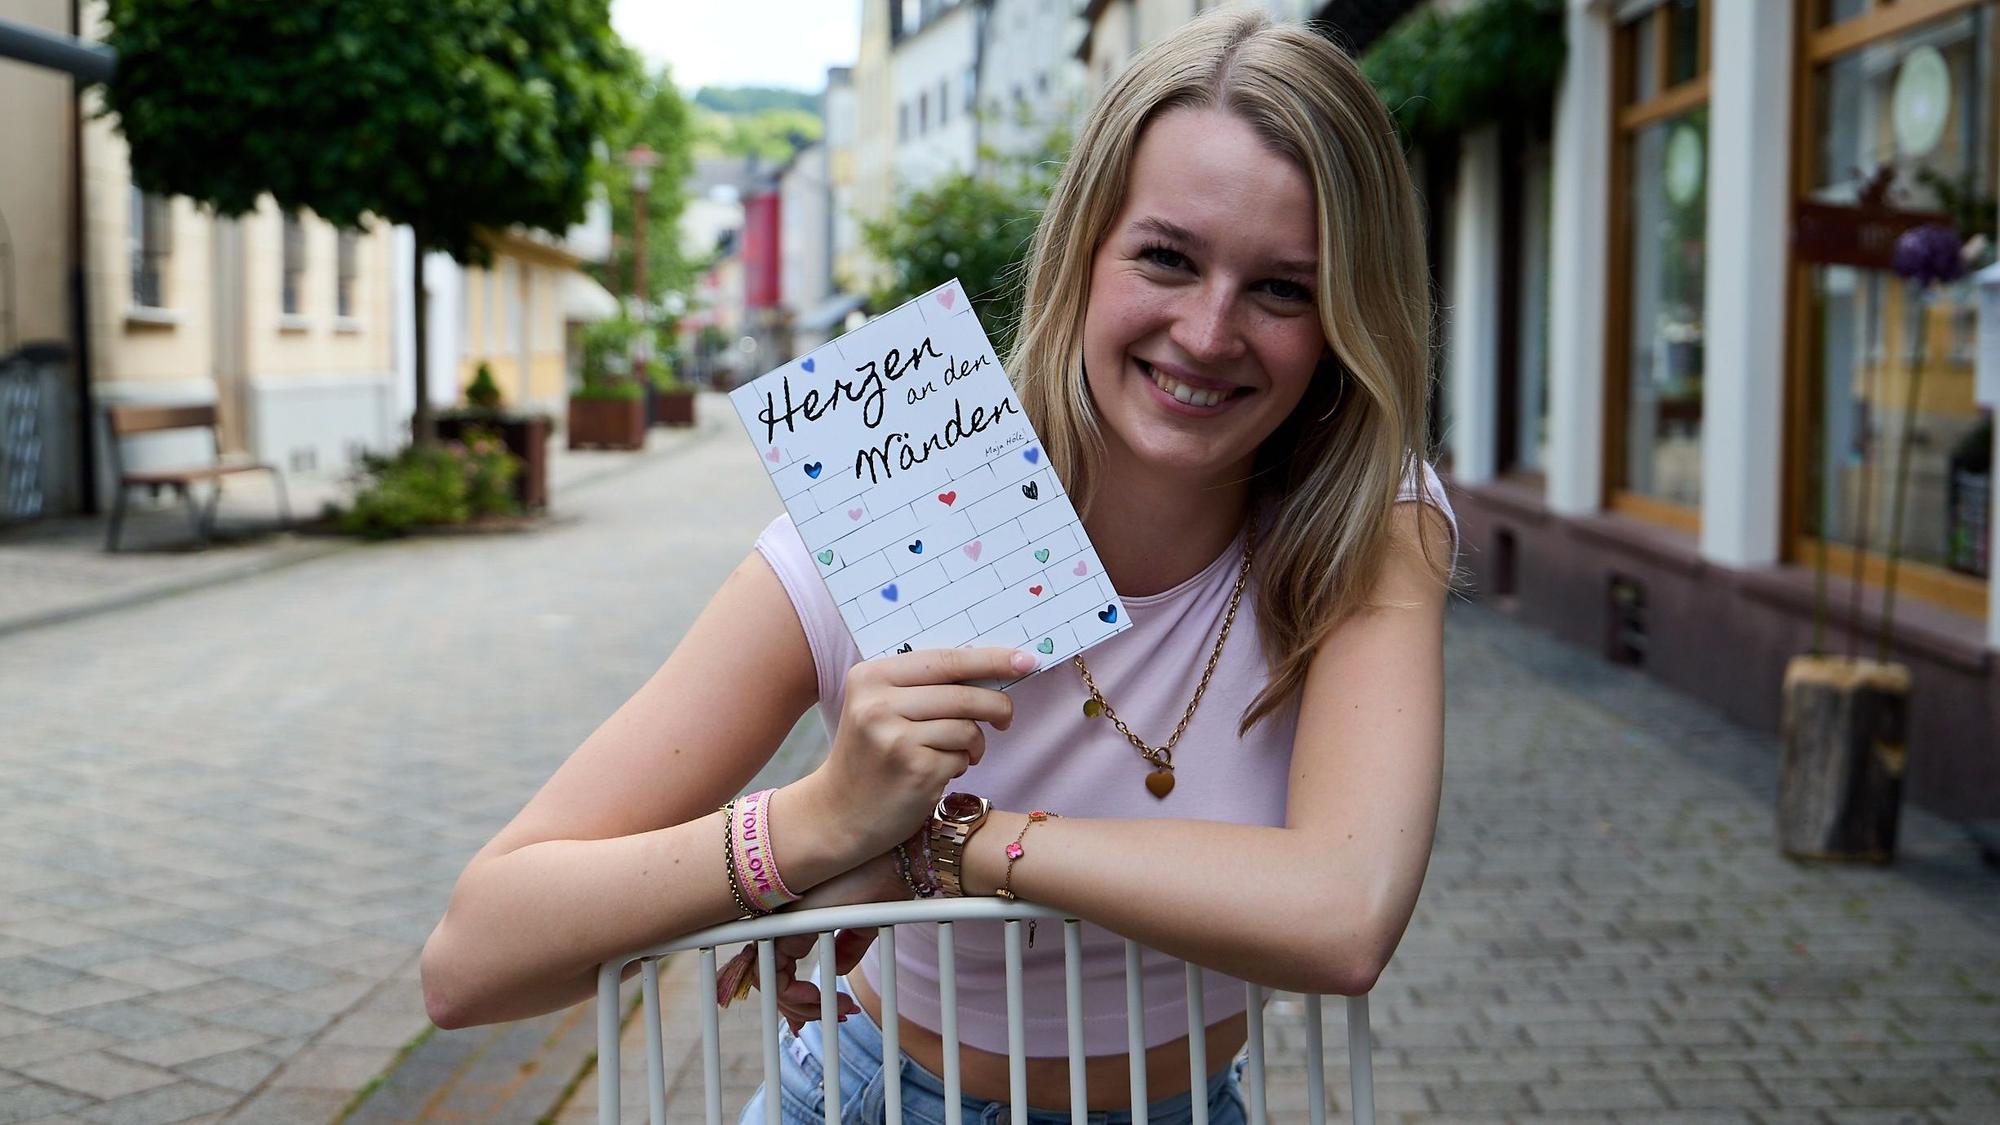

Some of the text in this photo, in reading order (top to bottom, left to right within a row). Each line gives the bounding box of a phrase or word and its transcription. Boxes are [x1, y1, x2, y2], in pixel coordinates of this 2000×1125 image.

[758, 337, 943, 444] Herzen
[906, 354, 991, 405] an den
[855, 397, 1019, 484] Wänden
[985, 444, 1004, 457] Maja
[743, 806, 757, 840] YOU
[746, 846, 771, 892] LOVE
